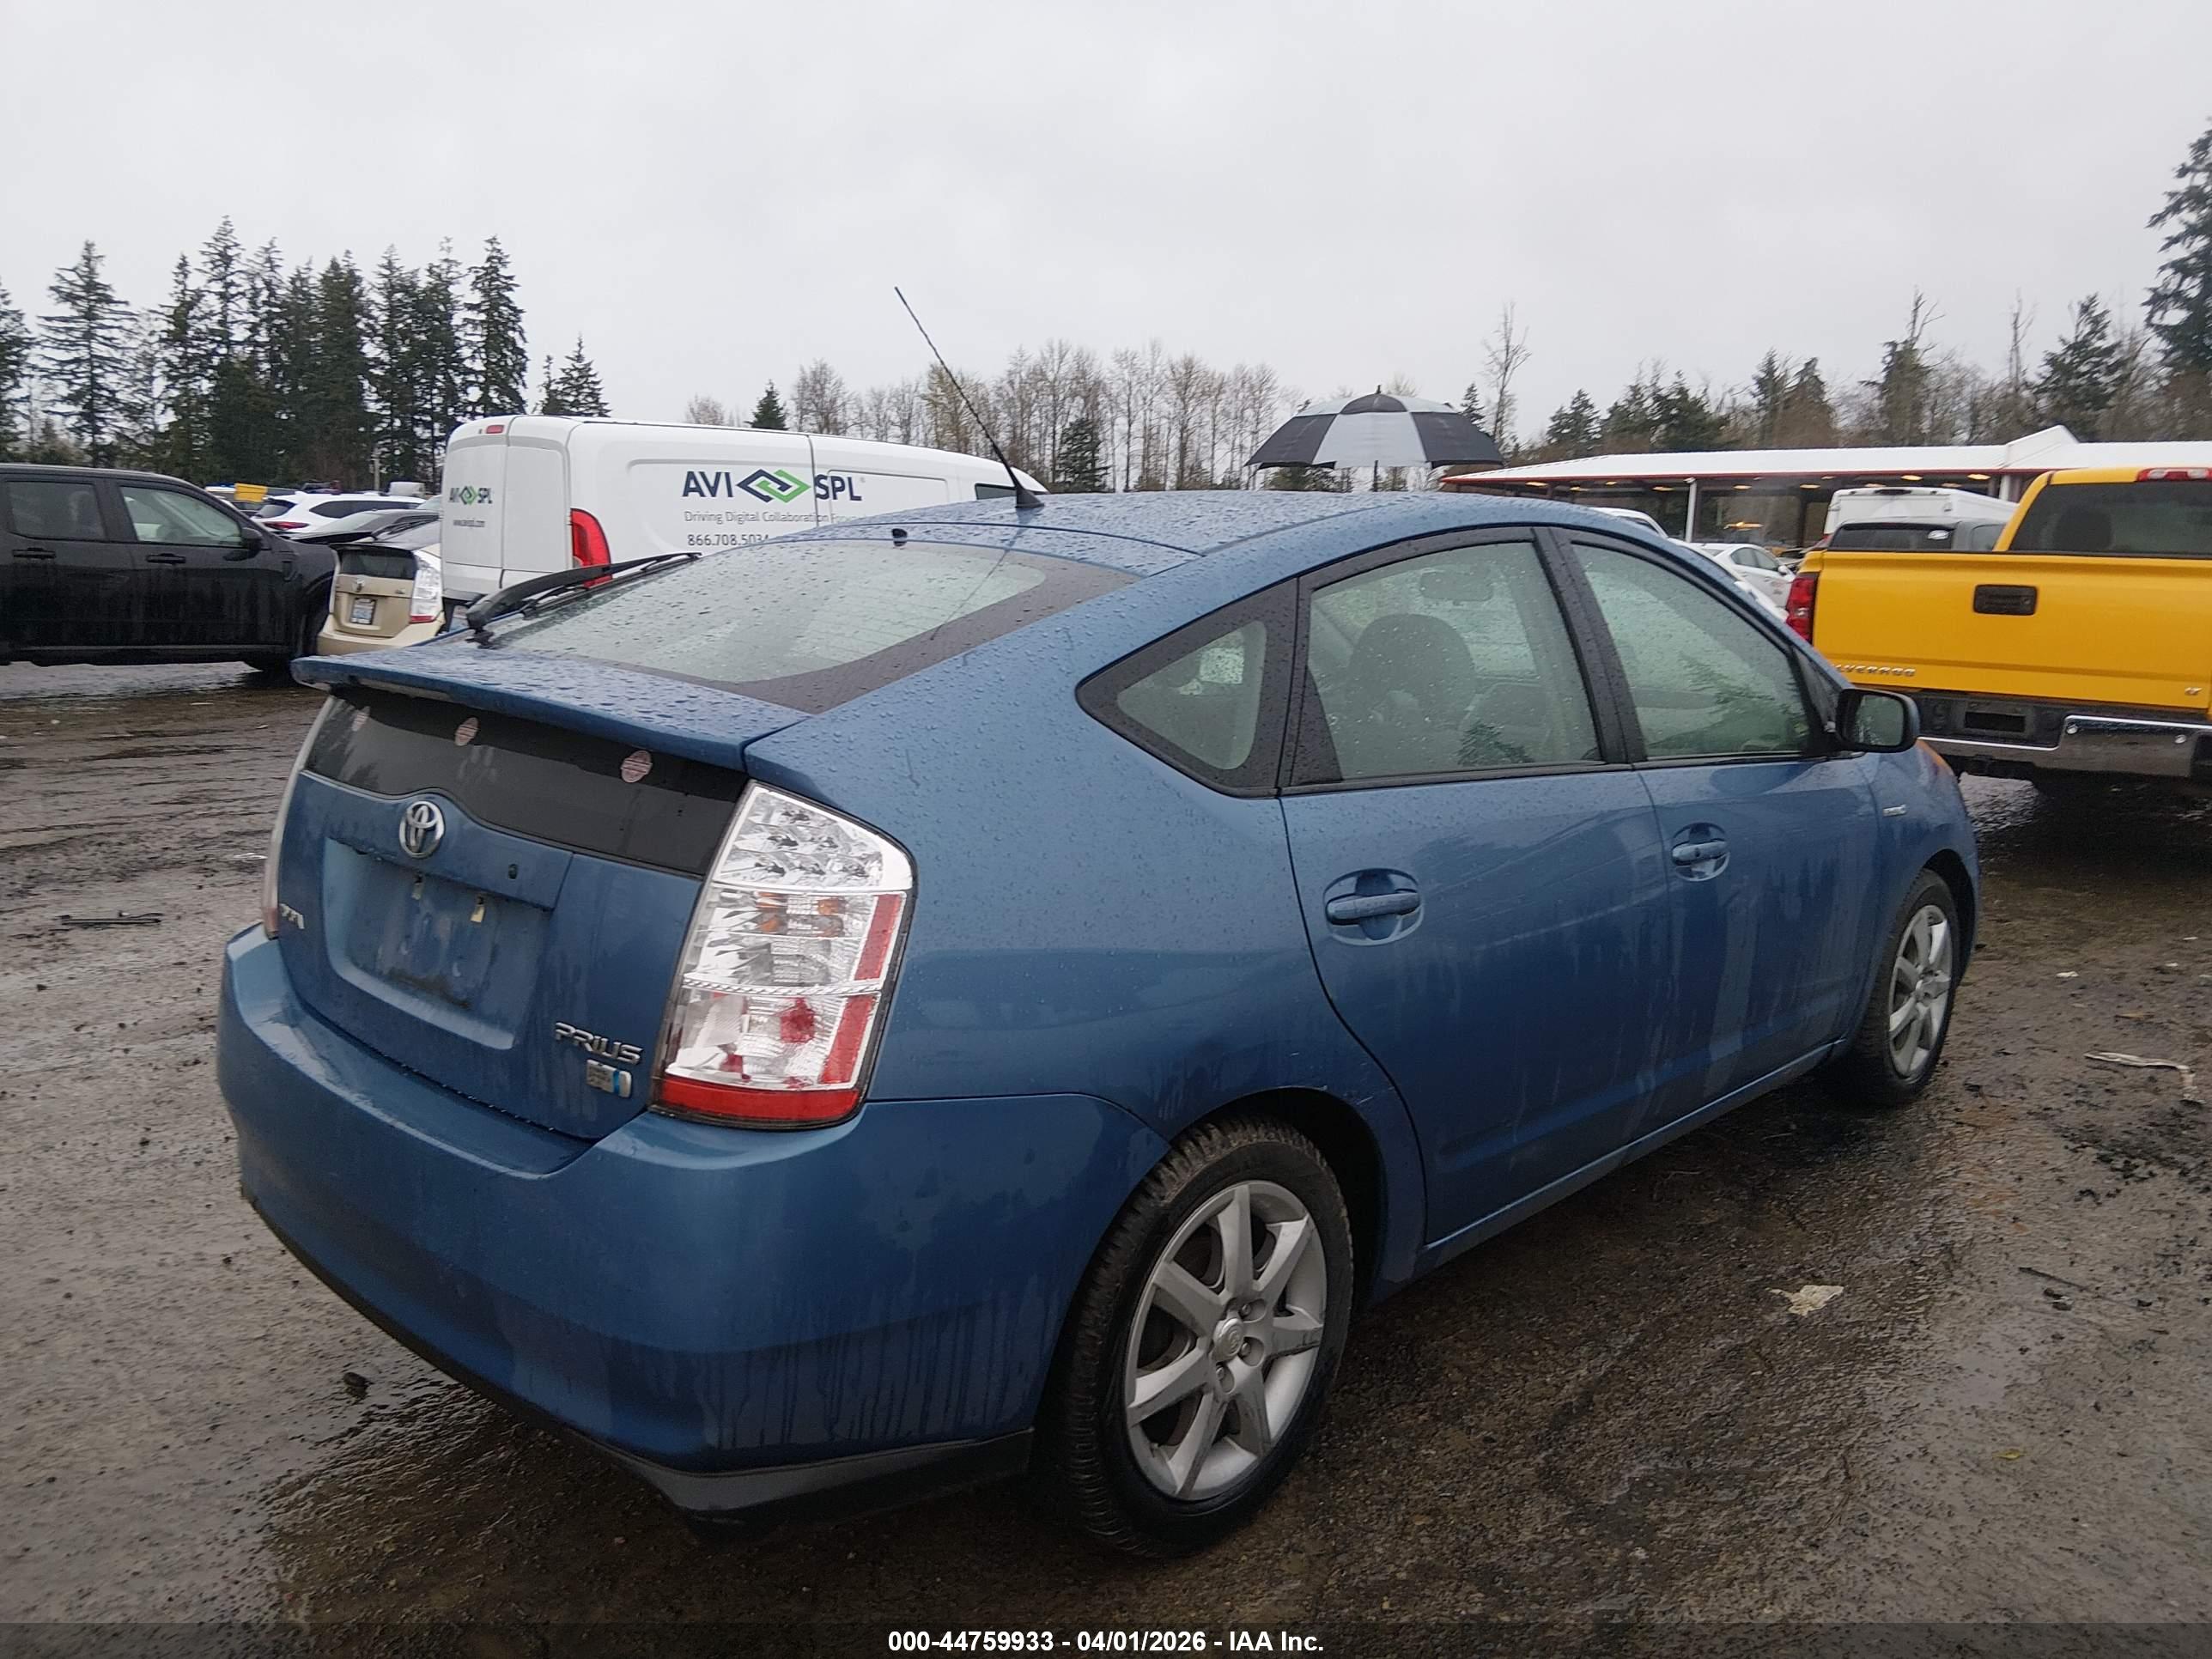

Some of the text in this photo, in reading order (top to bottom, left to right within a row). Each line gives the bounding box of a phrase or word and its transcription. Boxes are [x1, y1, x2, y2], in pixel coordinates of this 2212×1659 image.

[683, 471, 862, 501] AVI SPL
[684, 511, 723, 525] Driving
[726, 511, 759, 525] Digital
[763, 512, 828, 522] Collaboration
[555, 1022, 643, 1064] PRIUS
